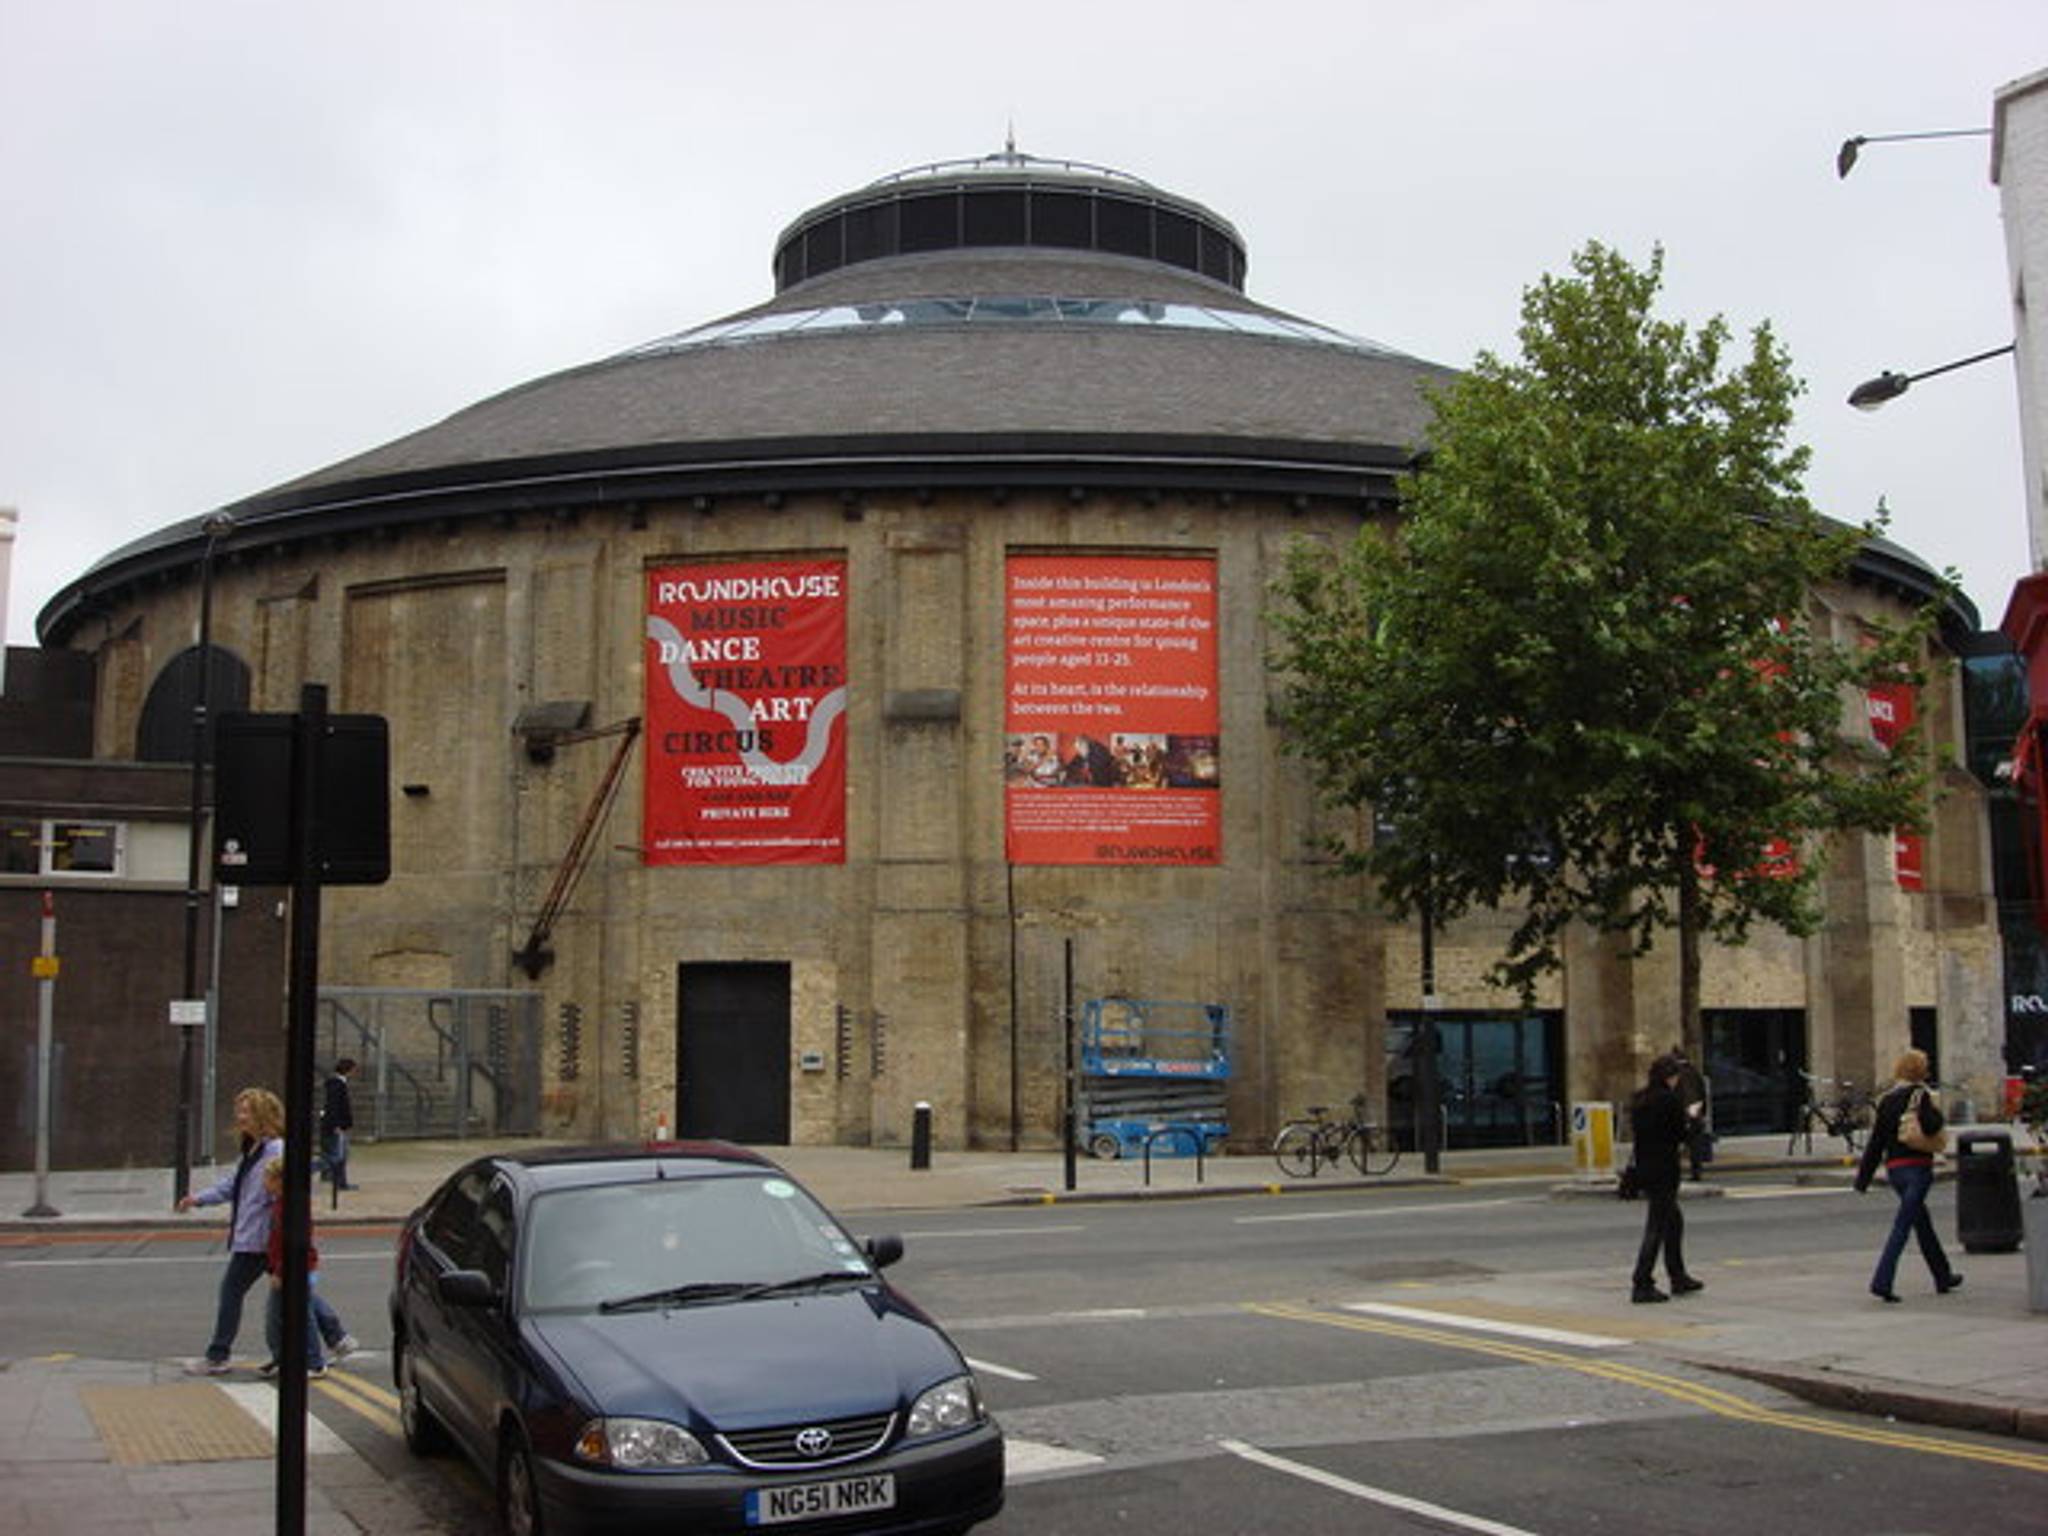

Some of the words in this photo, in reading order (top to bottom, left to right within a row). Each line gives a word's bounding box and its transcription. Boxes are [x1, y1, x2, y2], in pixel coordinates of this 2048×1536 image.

[659, 575, 840, 604] ROUNDHOUSE
[1013, 577, 1053, 590] Inside
[1056, 577, 1082, 590] this
[1085, 577, 1138, 593] building
[1013, 597, 1045, 609] most
[1048, 597, 1105, 611] amazing
[1107, 597, 1191, 611] performance
[691, 606, 789, 632] MUSIC
[1052, 616, 1079, 630] plus
[1091, 618, 1136, 631] unique
[659, 636, 760, 665] DANCE
[1013, 636, 1031, 646] art
[1033, 635, 1087, 647] creative
[1089, 635, 1131, 647] centre
[1134, 635, 1152, 647] for
[1155, 638, 1198, 651] young
[1013, 654, 1057, 668] people
[1060, 654, 1091, 668] aged
[693, 664, 840, 692] THEATRE
[1012, 682, 1028, 696] At
[1031, 682, 1049, 696] its
[1090, 684, 1102, 696] is
[1104, 683, 1127, 696] the
[1129, 683, 1208, 700] relationship
[749, 697, 813, 721] ART
[1012, 701, 1070, 715] between
[1072, 701, 1094, 714] the
[664, 729, 775, 754] CIRCUS
[701, 807, 756, 819] PRIVATE
[758, 806, 790, 818] HIRE
[1095, 844, 1215, 859] ROUNDHOUSE
[770, 1485, 830, 1517] NG51
[837, 1477, 888, 1508] NRK
